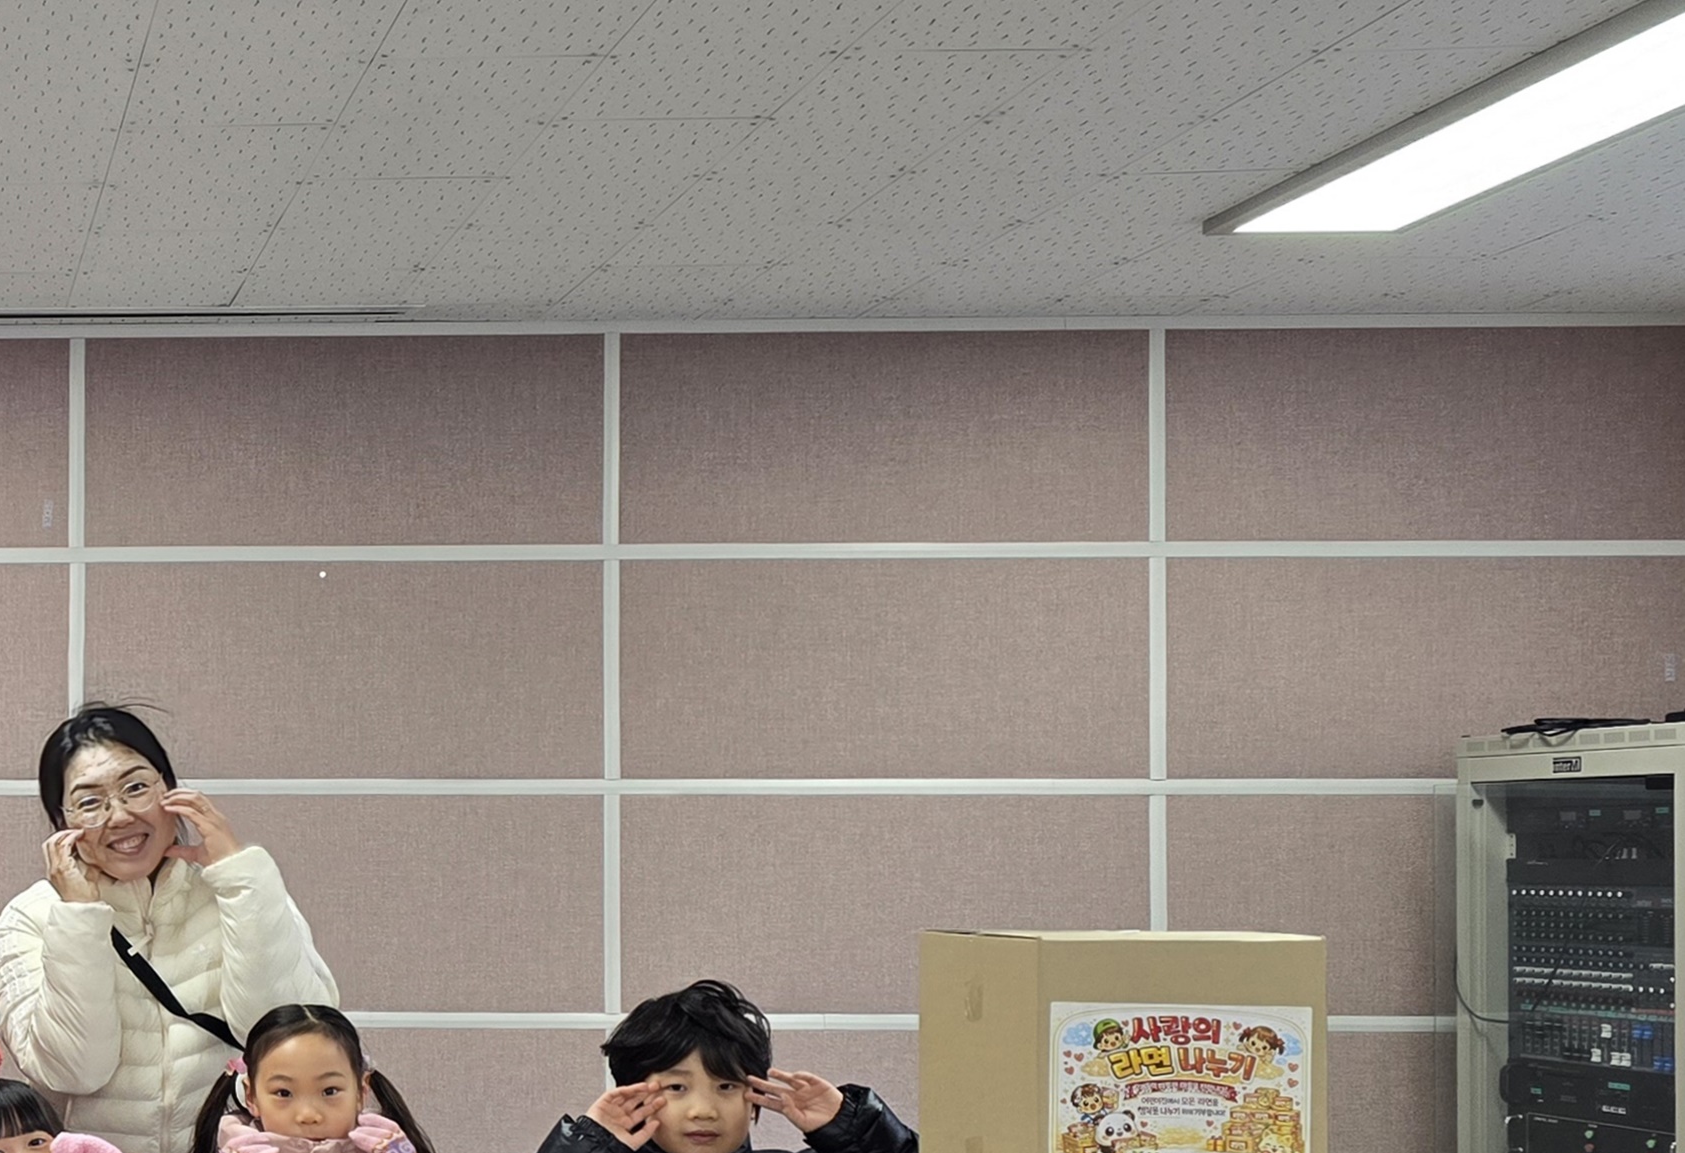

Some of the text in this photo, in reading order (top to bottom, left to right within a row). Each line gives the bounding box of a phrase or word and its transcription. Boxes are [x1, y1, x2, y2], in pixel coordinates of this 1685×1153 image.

[1130, 1015, 1220, 1045] 사랑의
[1108, 1044, 1258, 1080] 라면 나누기
